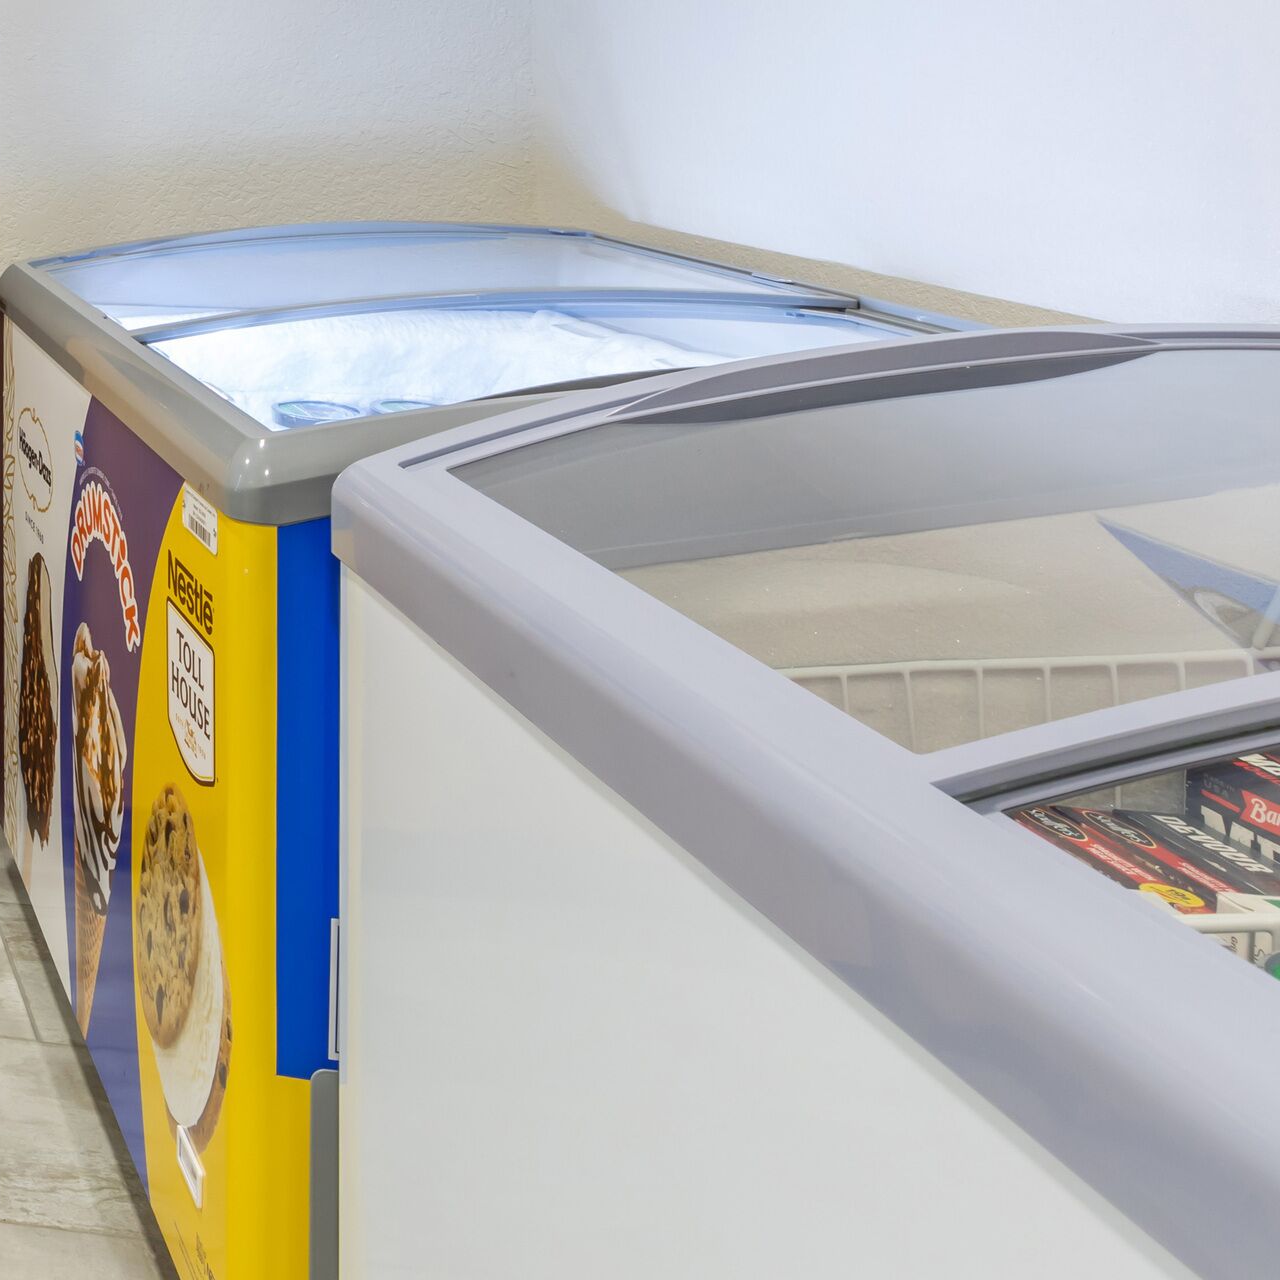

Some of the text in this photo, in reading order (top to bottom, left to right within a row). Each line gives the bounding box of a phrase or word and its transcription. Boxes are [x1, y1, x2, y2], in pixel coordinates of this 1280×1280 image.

[72, 480, 141, 653] DRUMSTICK
[175, 626, 206, 692] TOLL
[170, 660, 212, 742] HOUSE
[1150, 814, 1275, 874] DEVOUR
